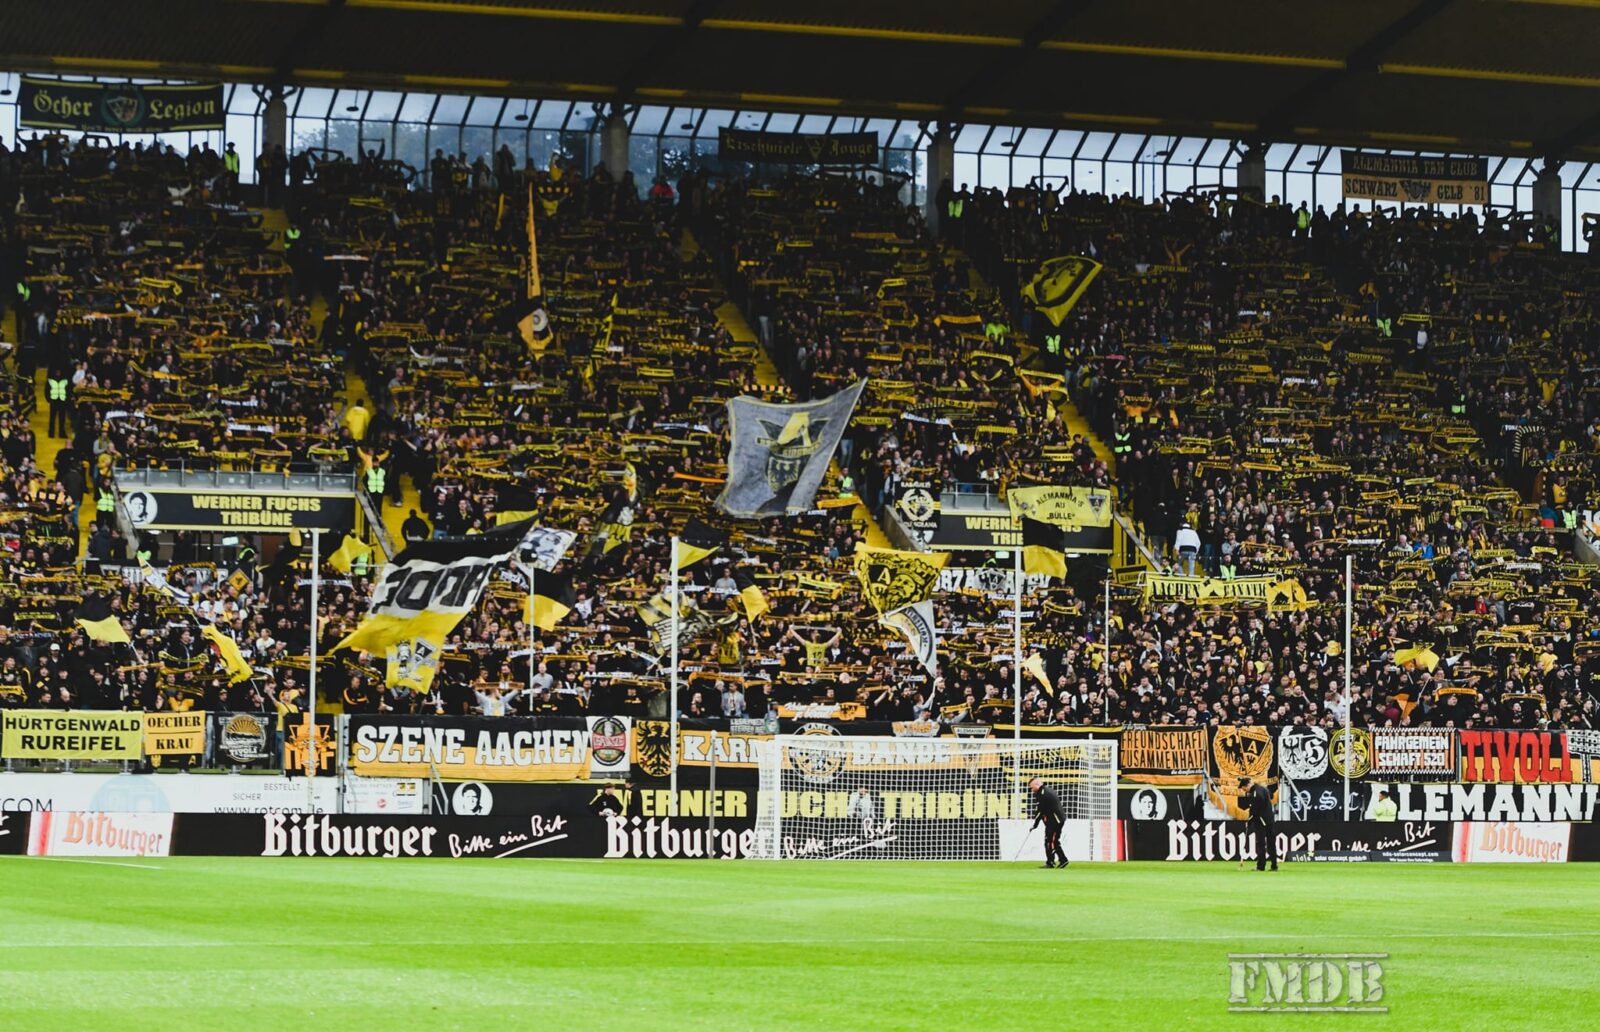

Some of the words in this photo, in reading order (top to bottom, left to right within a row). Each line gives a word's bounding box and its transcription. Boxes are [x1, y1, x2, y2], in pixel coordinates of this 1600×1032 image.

[33, 89, 93, 118] Öcher
[149, 98, 215, 120] Legion
[1352, 155, 1418, 175] ALEMANNIA
[1424, 159, 1445, 176] FAN
[1450, 161, 1478, 176] CLUB
[1345, 178, 1398, 197] SCHWARZ
[1437, 184, 1463, 200] GELB
[192, 495, 263, 511] WERNER
[266, 496, 321, 512] FUCHS
[220, 510, 293, 526] TRIBÜNE
[5, 714, 141, 732] HÜRTGENWALD
[147, 715, 201, 728] OECHER
[21, 735, 126, 751] RUREIFEL
[156, 738, 194, 751] KRAU
[356, 724, 466, 764] SZENE
[474, 729, 591, 766] AACHEN
[1121, 730, 1202, 750] FREUNDSCHAFT
[1121, 750, 1203, 769] ZUSAMMENHALT
[1378, 752, 1421, 766] SCHAFT
[1460, 729, 1573, 782] TIVOLI
[263, 783, 301, 791] BESTELLT
[232, 793, 262, 801] SICHER
[62, 811, 163, 856] Bitburger
[261, 813, 437, 858] Bitburger
[448, 833, 494, 858] Bitte
[499, 831, 528, 846] ein
[531, 814, 568, 837] Bit
[1166, 818, 1322, 863] Bitbuger
[1376, 837, 1401, 850] ein
[1404, 821, 1436, 844] Bit
[1479, 821, 1562, 861] Bitburger
